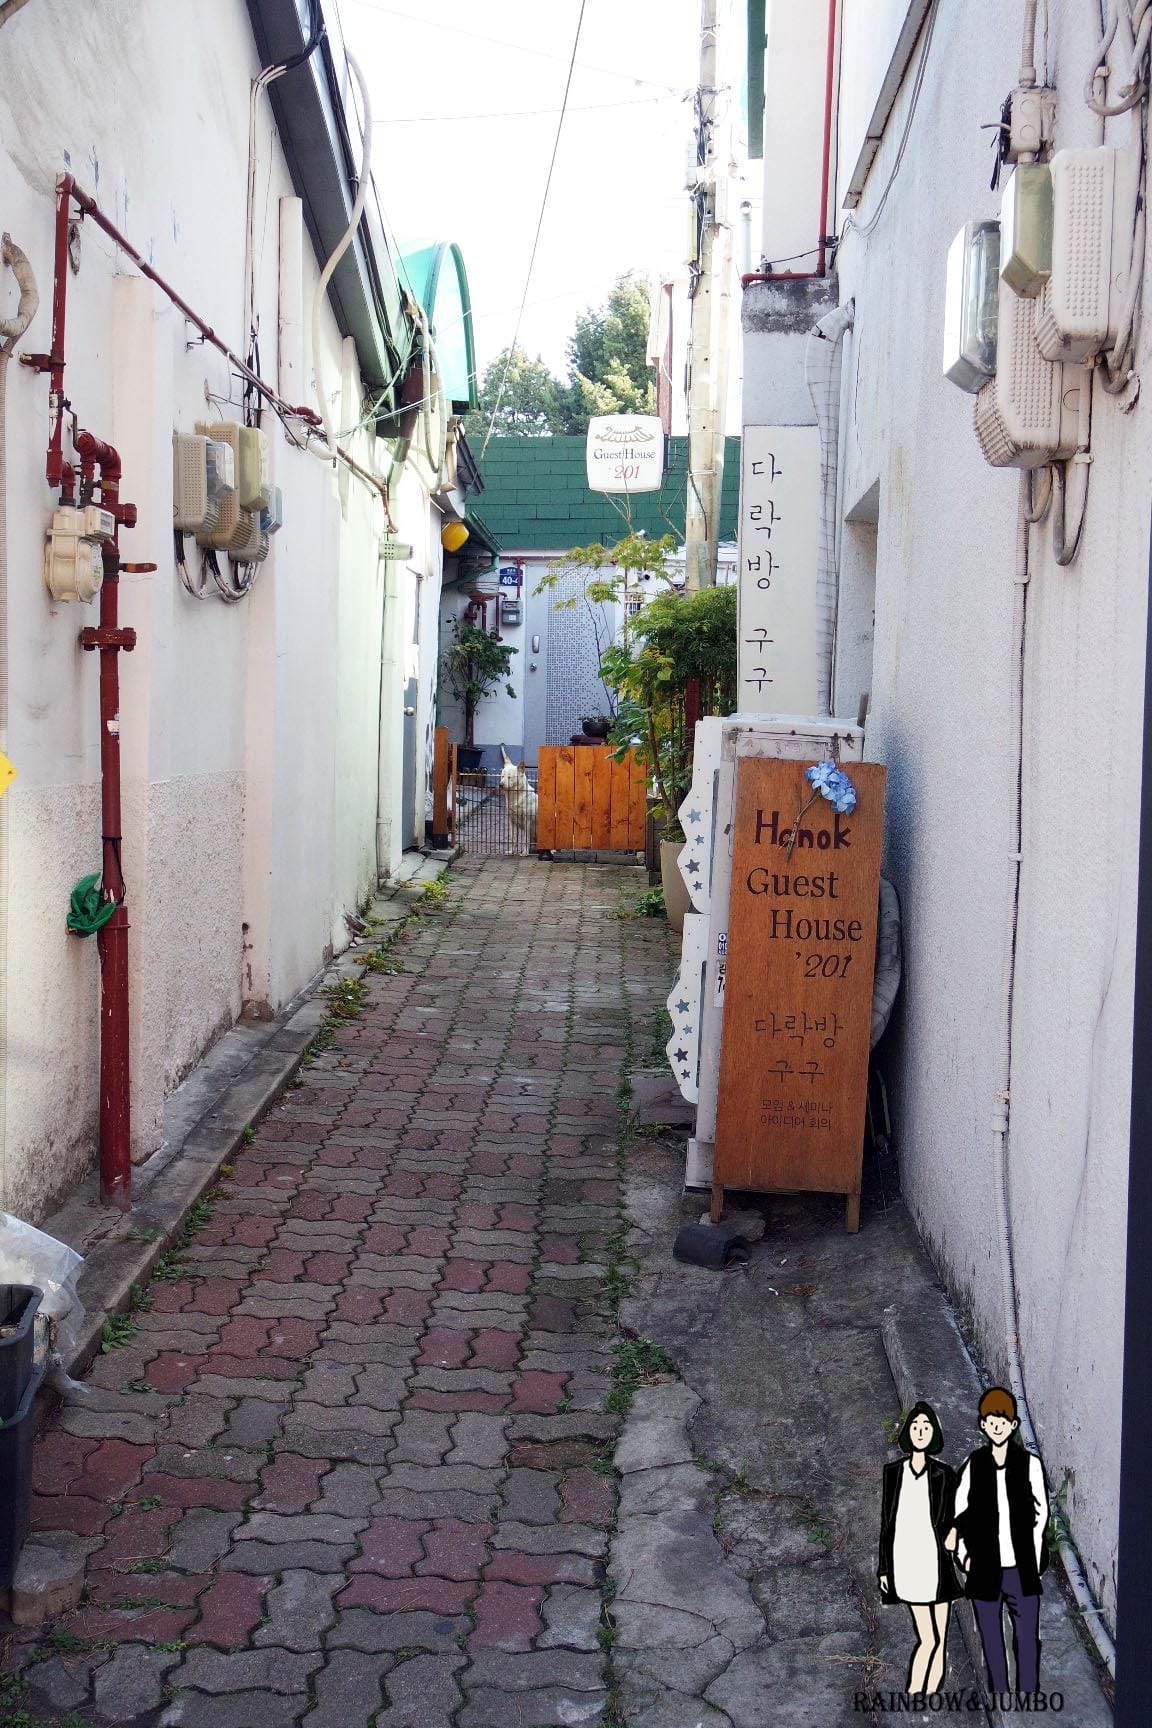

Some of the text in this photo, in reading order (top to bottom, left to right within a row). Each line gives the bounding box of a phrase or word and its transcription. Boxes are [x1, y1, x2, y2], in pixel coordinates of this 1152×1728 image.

[594, 448, 656, 460] Guest House
[744, 452, 783, 694] 다락방 구구
[754, 809, 852, 850] Hanok
[746, 867, 839, 899] Guest
[769, 909, 863, 942] House
[755, 1011, 844, 1048] 다락방
[798, 1100, 834, 1115] 세미나
[808, 1116, 831, 1132] 회의
